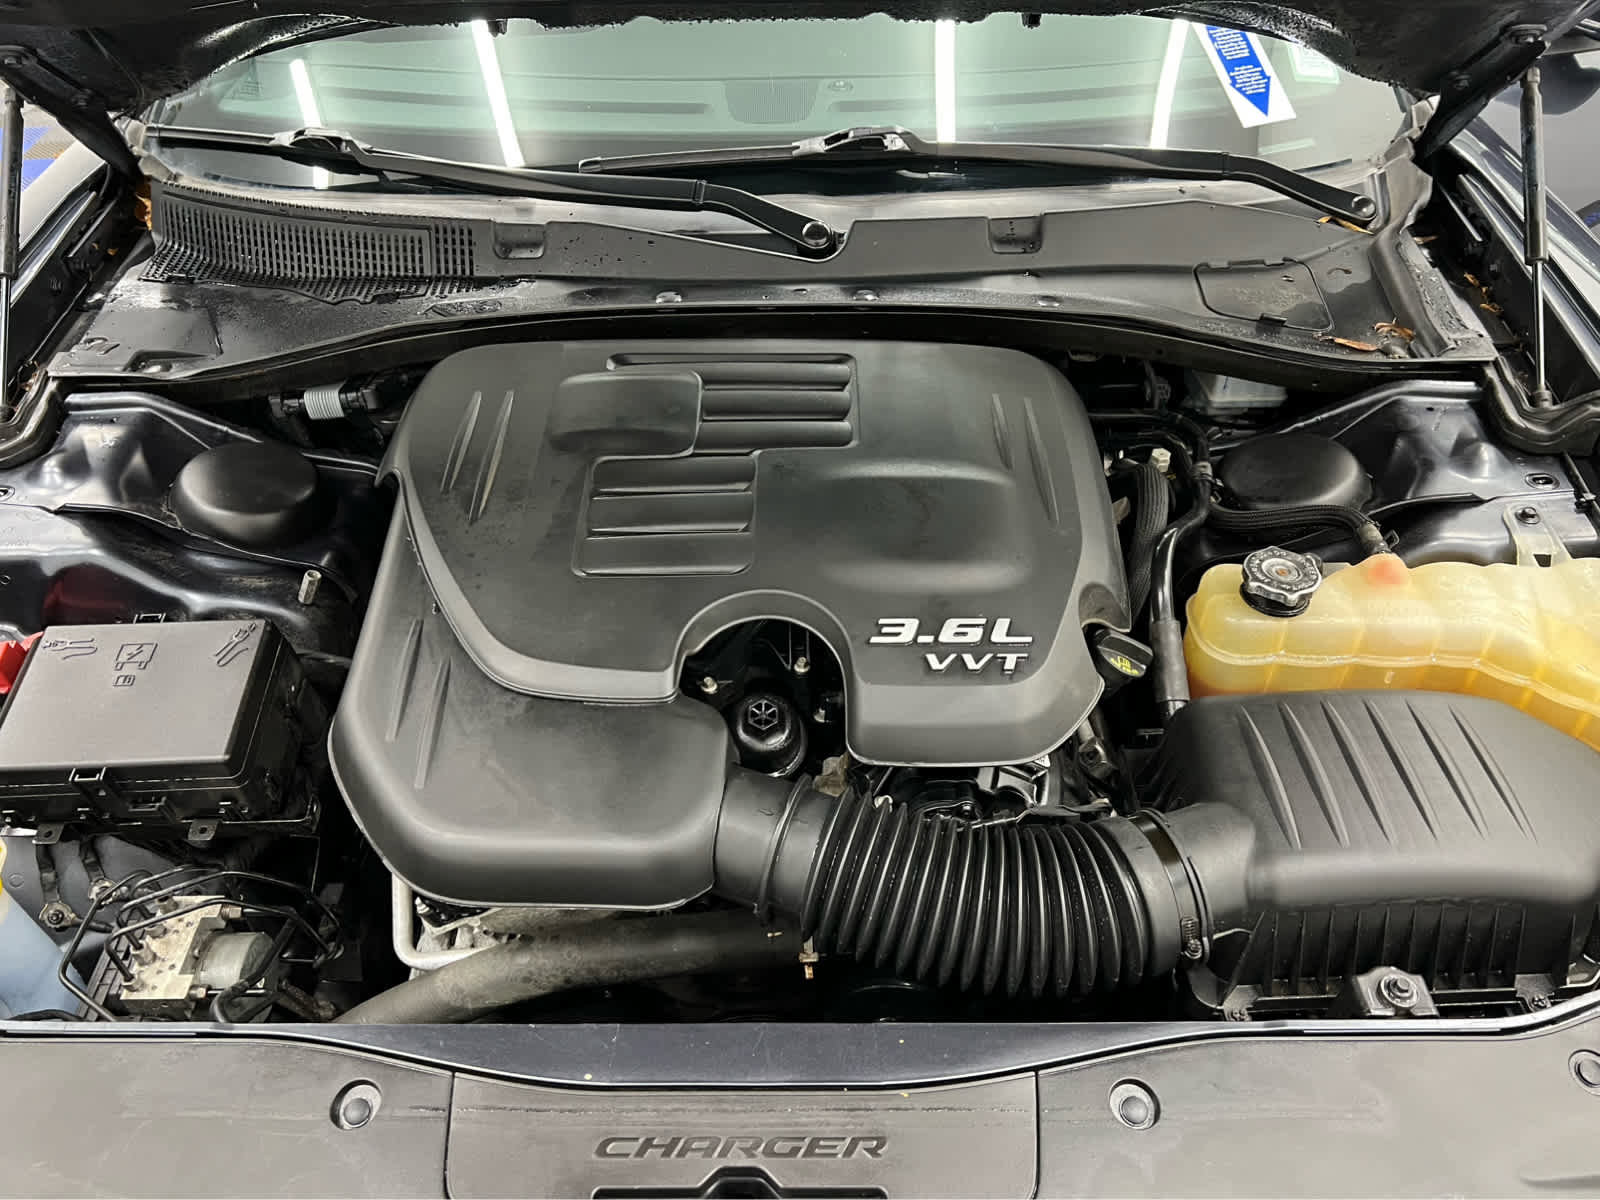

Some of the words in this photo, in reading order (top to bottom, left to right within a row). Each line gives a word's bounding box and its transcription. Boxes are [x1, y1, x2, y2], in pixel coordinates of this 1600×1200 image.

[869, 617, 1033, 645] 3.6L
[925, 653, 1028, 673] VVT
[594, 1136, 889, 1159] CHARGER
